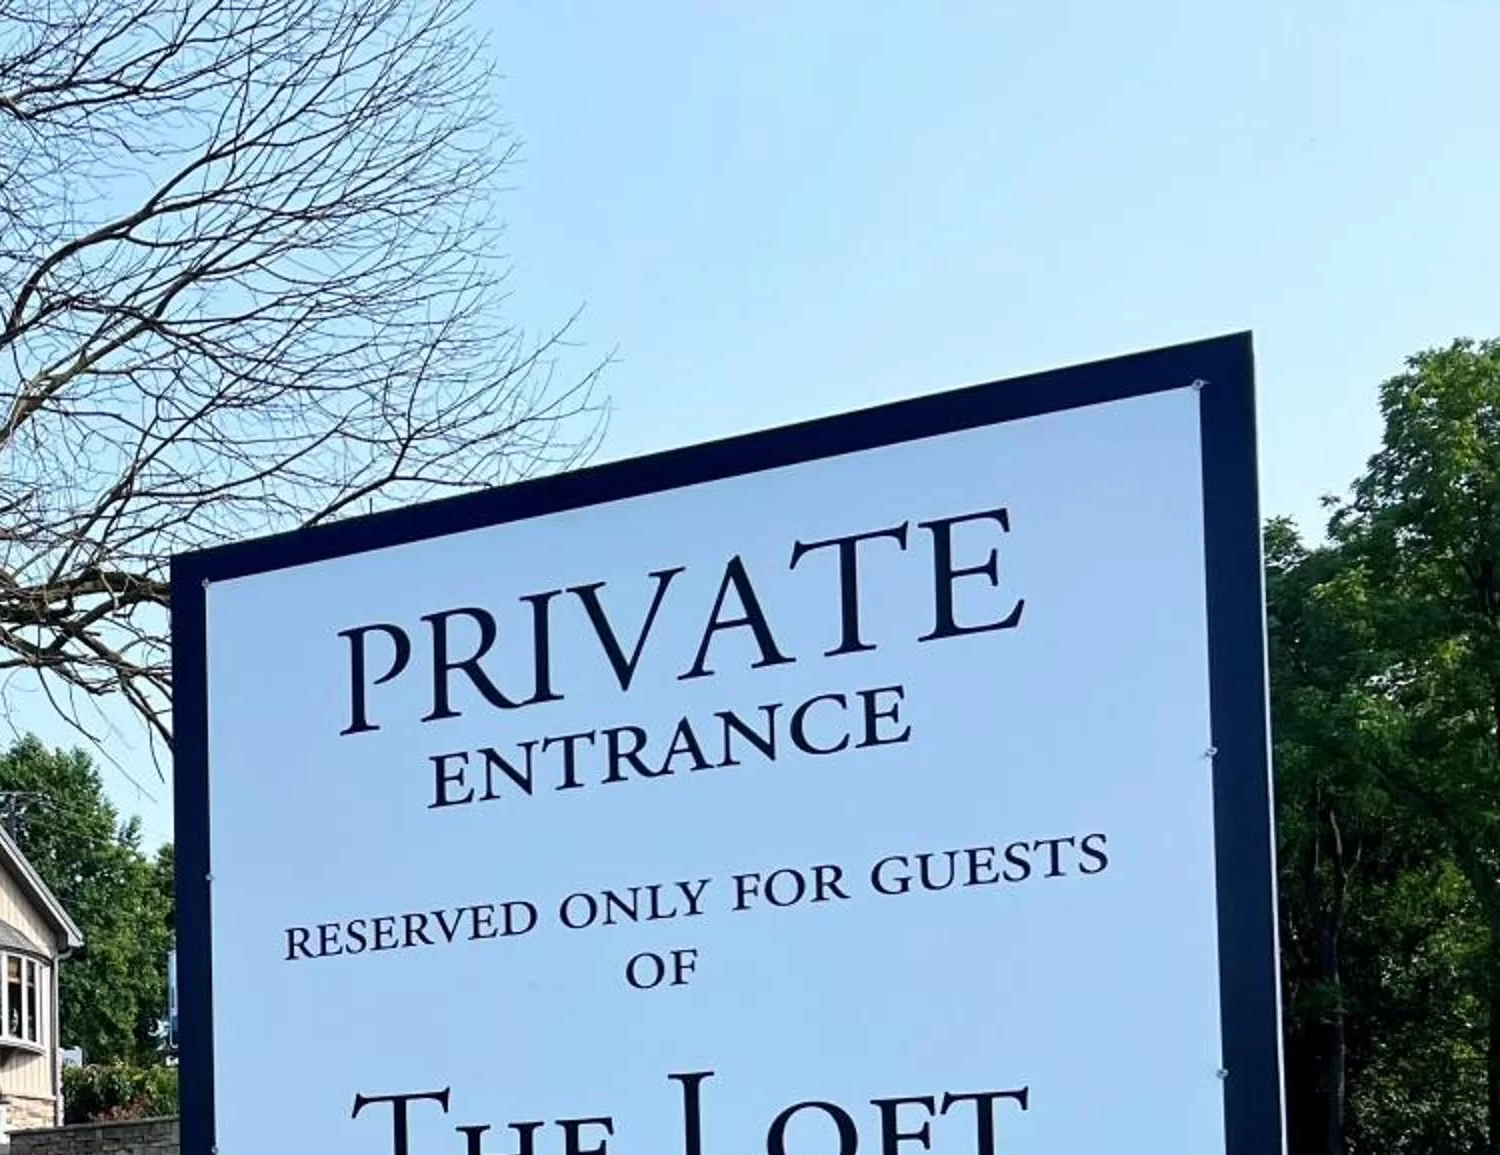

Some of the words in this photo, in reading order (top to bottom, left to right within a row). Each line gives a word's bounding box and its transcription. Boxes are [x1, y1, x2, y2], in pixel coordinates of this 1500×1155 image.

[338, 507, 1026, 736] PRIVATE
[427, 685, 912, 809] ENTRANCE
[285, 901, 538, 961] RESERVED
[559, 879, 710, 929] ONLY
[732, 865, 850, 911] FOR
[871, 833, 1109, 895] GUESTS
[625, 949, 698, 989] OF
